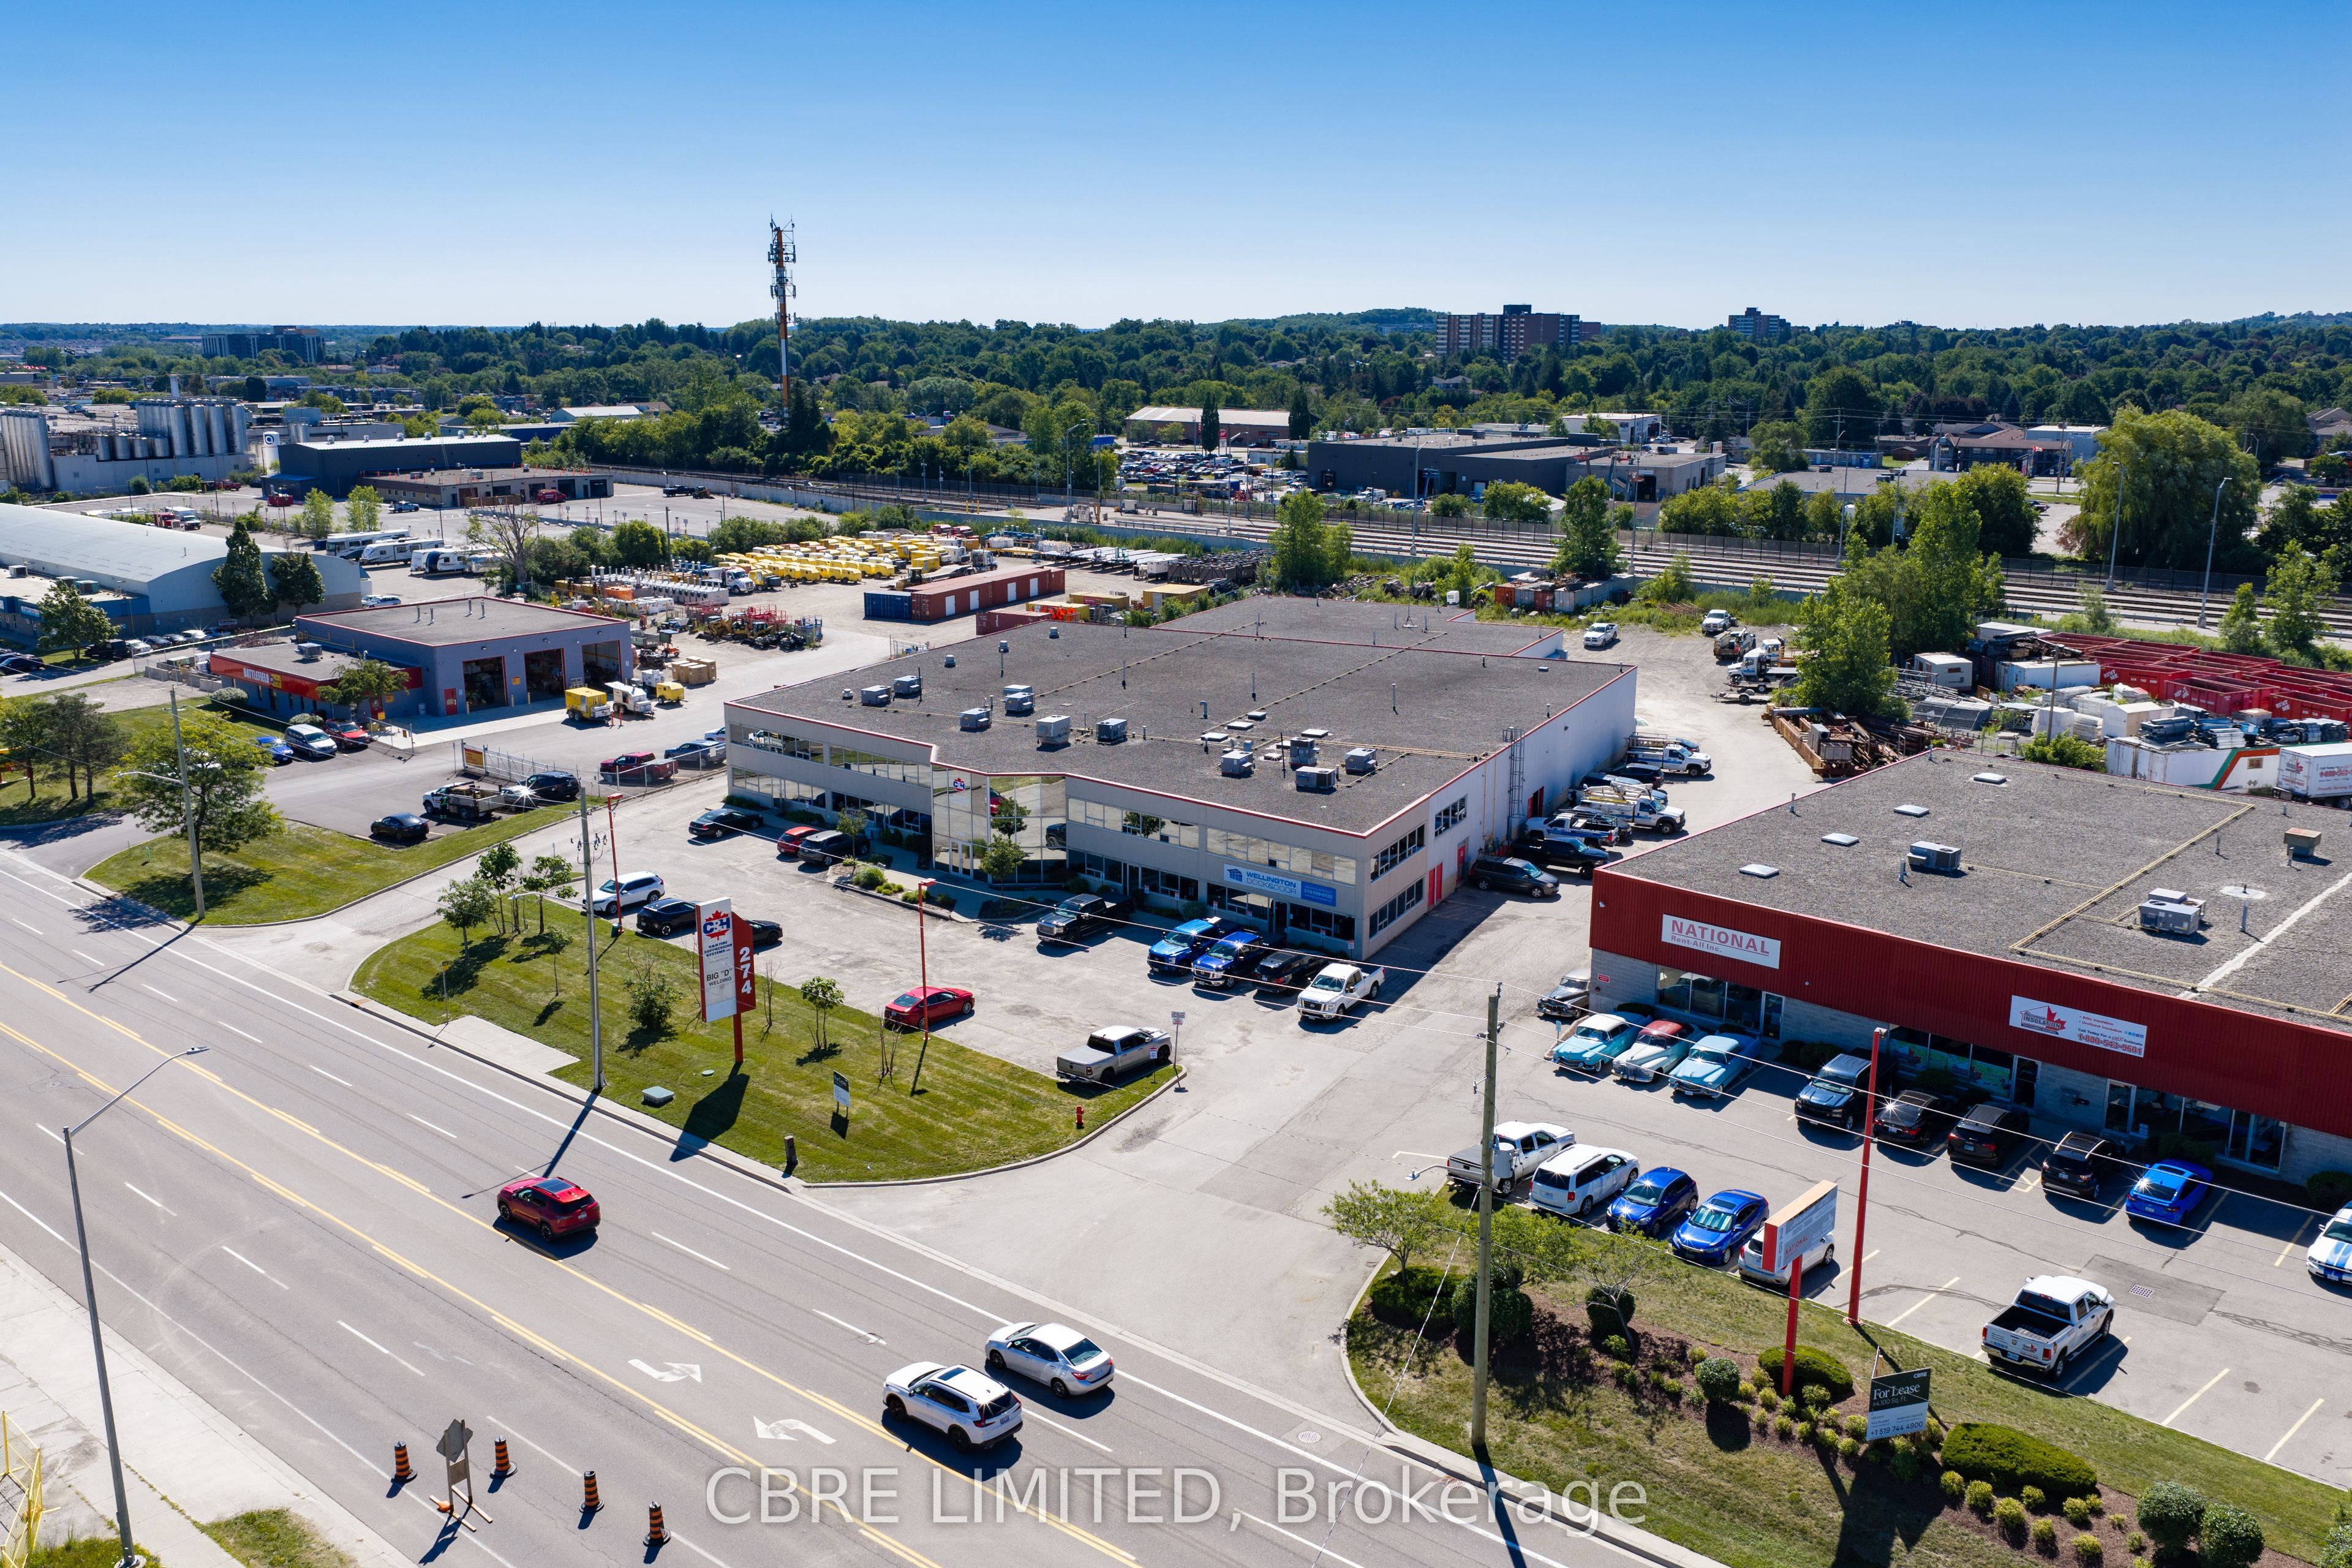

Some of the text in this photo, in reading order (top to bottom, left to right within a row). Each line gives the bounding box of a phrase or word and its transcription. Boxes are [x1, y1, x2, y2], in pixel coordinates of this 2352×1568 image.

[243, 668, 270, 684] BATTLEFIELD
[1246, 872, 1296, 888] WELLINGTON
[703, 917, 730, 934] C&H
[1671, 935, 1722, 952] Rent-All Inc.
[1672, 920, 1770, 954] NATIONAL
[704, 943, 733, 954] SUPPRESSION
[706, 971, 719, 981] BIG
[709, 976, 732, 986] WELDING
[2024, 1016, 2060, 1028] INSULATION
[1785, 1235, 1808, 1255] NATIONAL
[1873, 1384, 1920, 1401] For Lease
